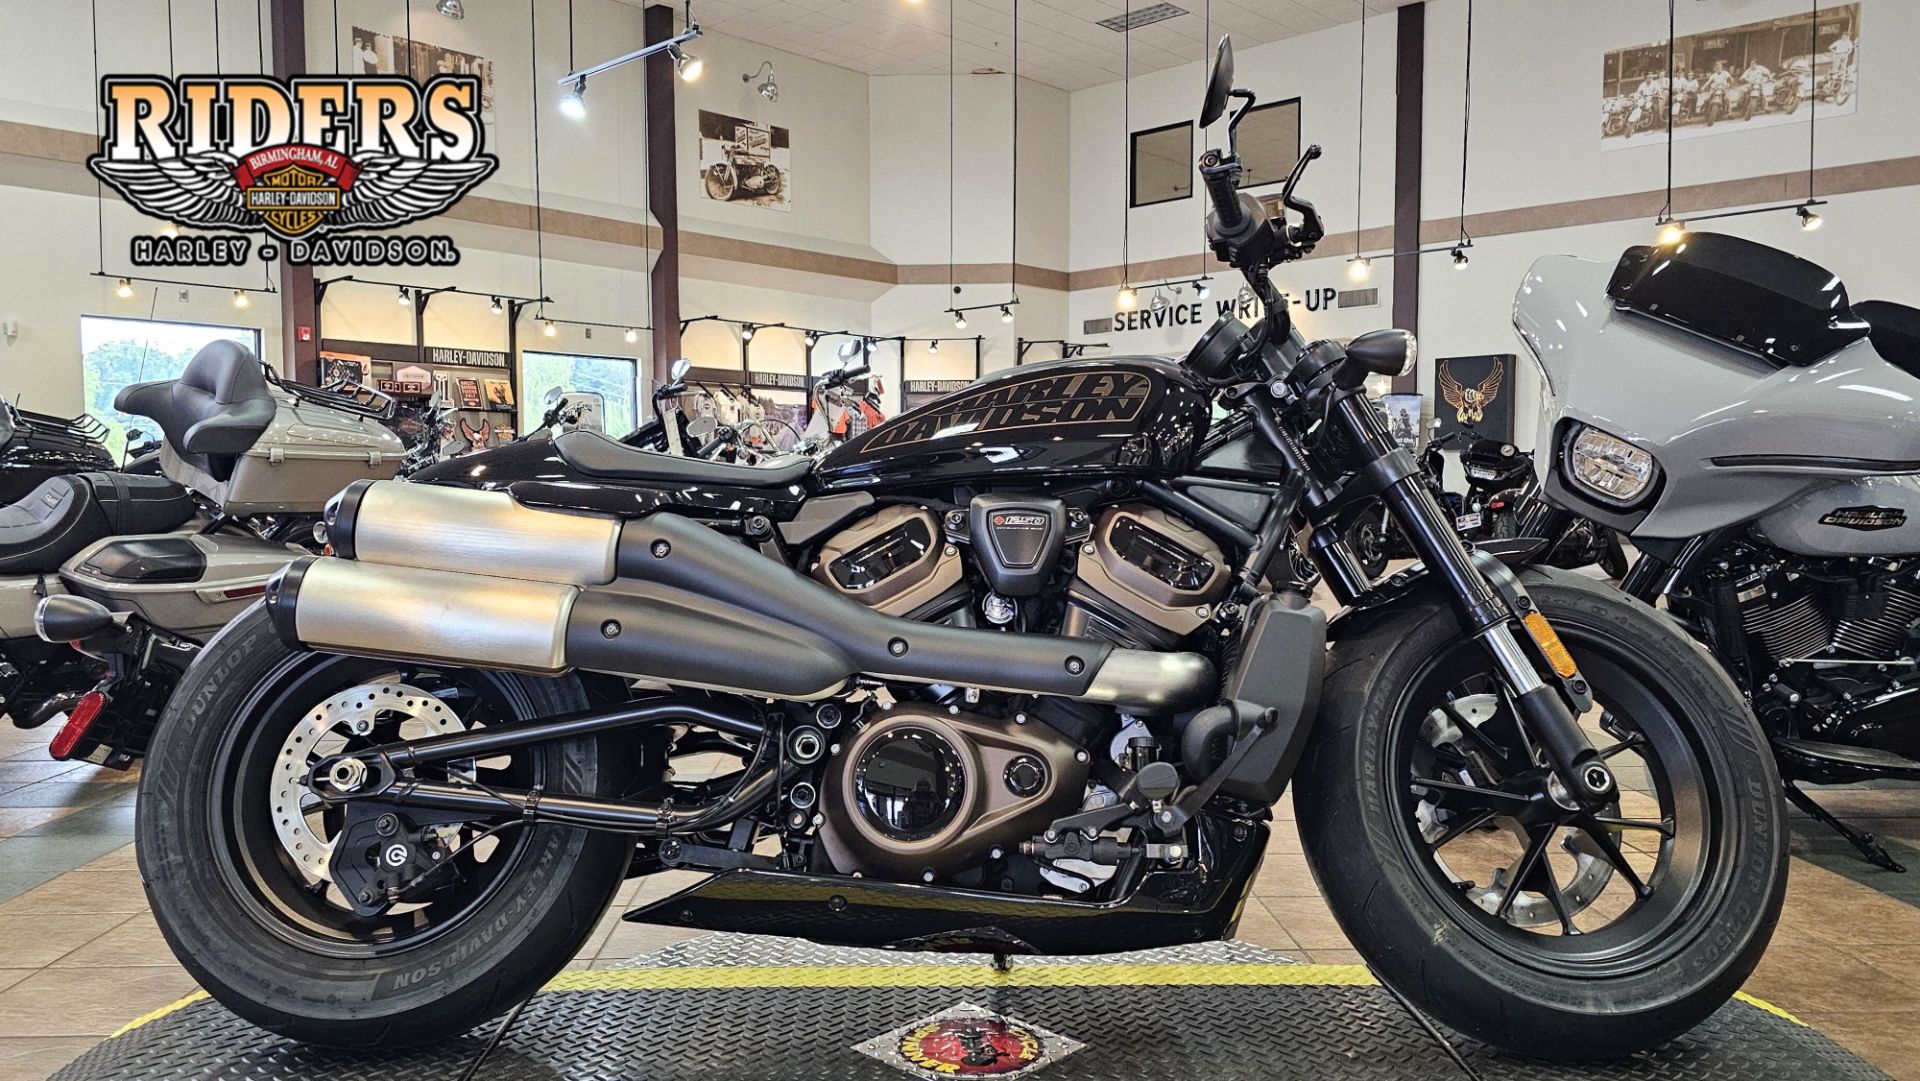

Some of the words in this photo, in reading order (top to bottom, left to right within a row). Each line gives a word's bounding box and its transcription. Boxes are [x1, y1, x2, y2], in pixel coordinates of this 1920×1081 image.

[1114, 303, 1202, 332] SERVICE
[432, 348, 505, 367] HARLEY-DAVIDSON
[183, 634, 258, 736] DUNLOP
[392, 831, 563, 990] ARLEY-DAVIDSON
